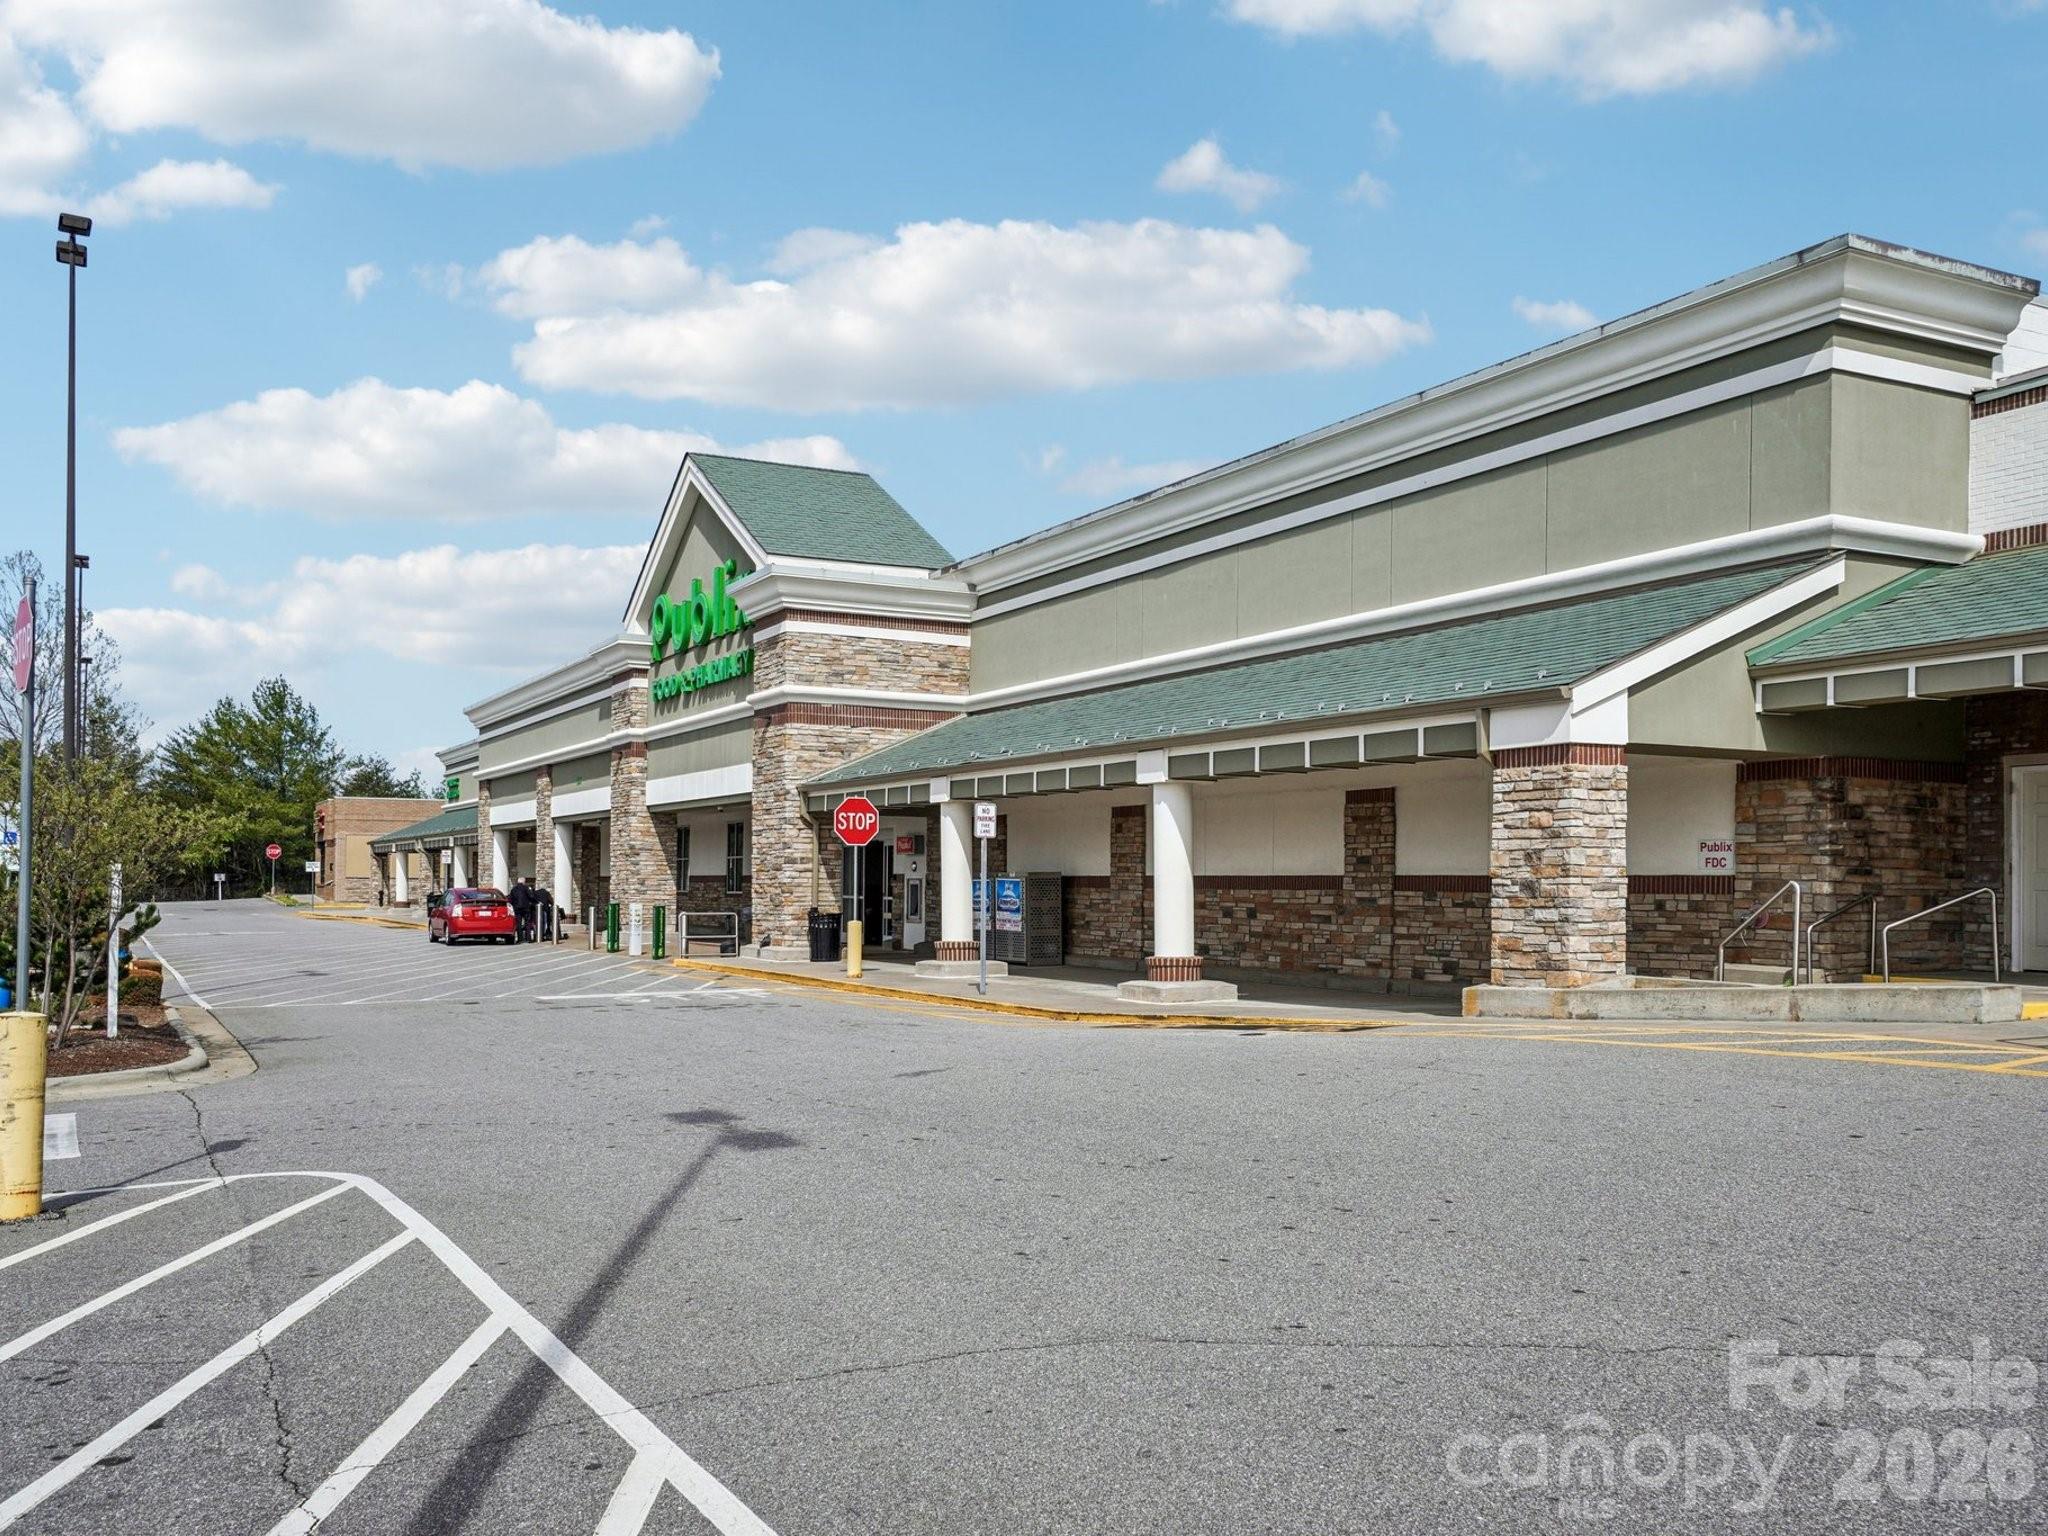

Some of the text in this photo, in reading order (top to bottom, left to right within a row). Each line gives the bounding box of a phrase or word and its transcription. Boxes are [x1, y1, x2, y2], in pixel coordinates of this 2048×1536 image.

[653, 674, 683, 703] FOOD
[692, 648, 754, 689] PHARMACY
[981, 807, 991, 815] NO
[837, 812, 876, 831] STOP
[1700, 841, 1733, 852] Publix
[1705, 857, 1727, 868] FDC
